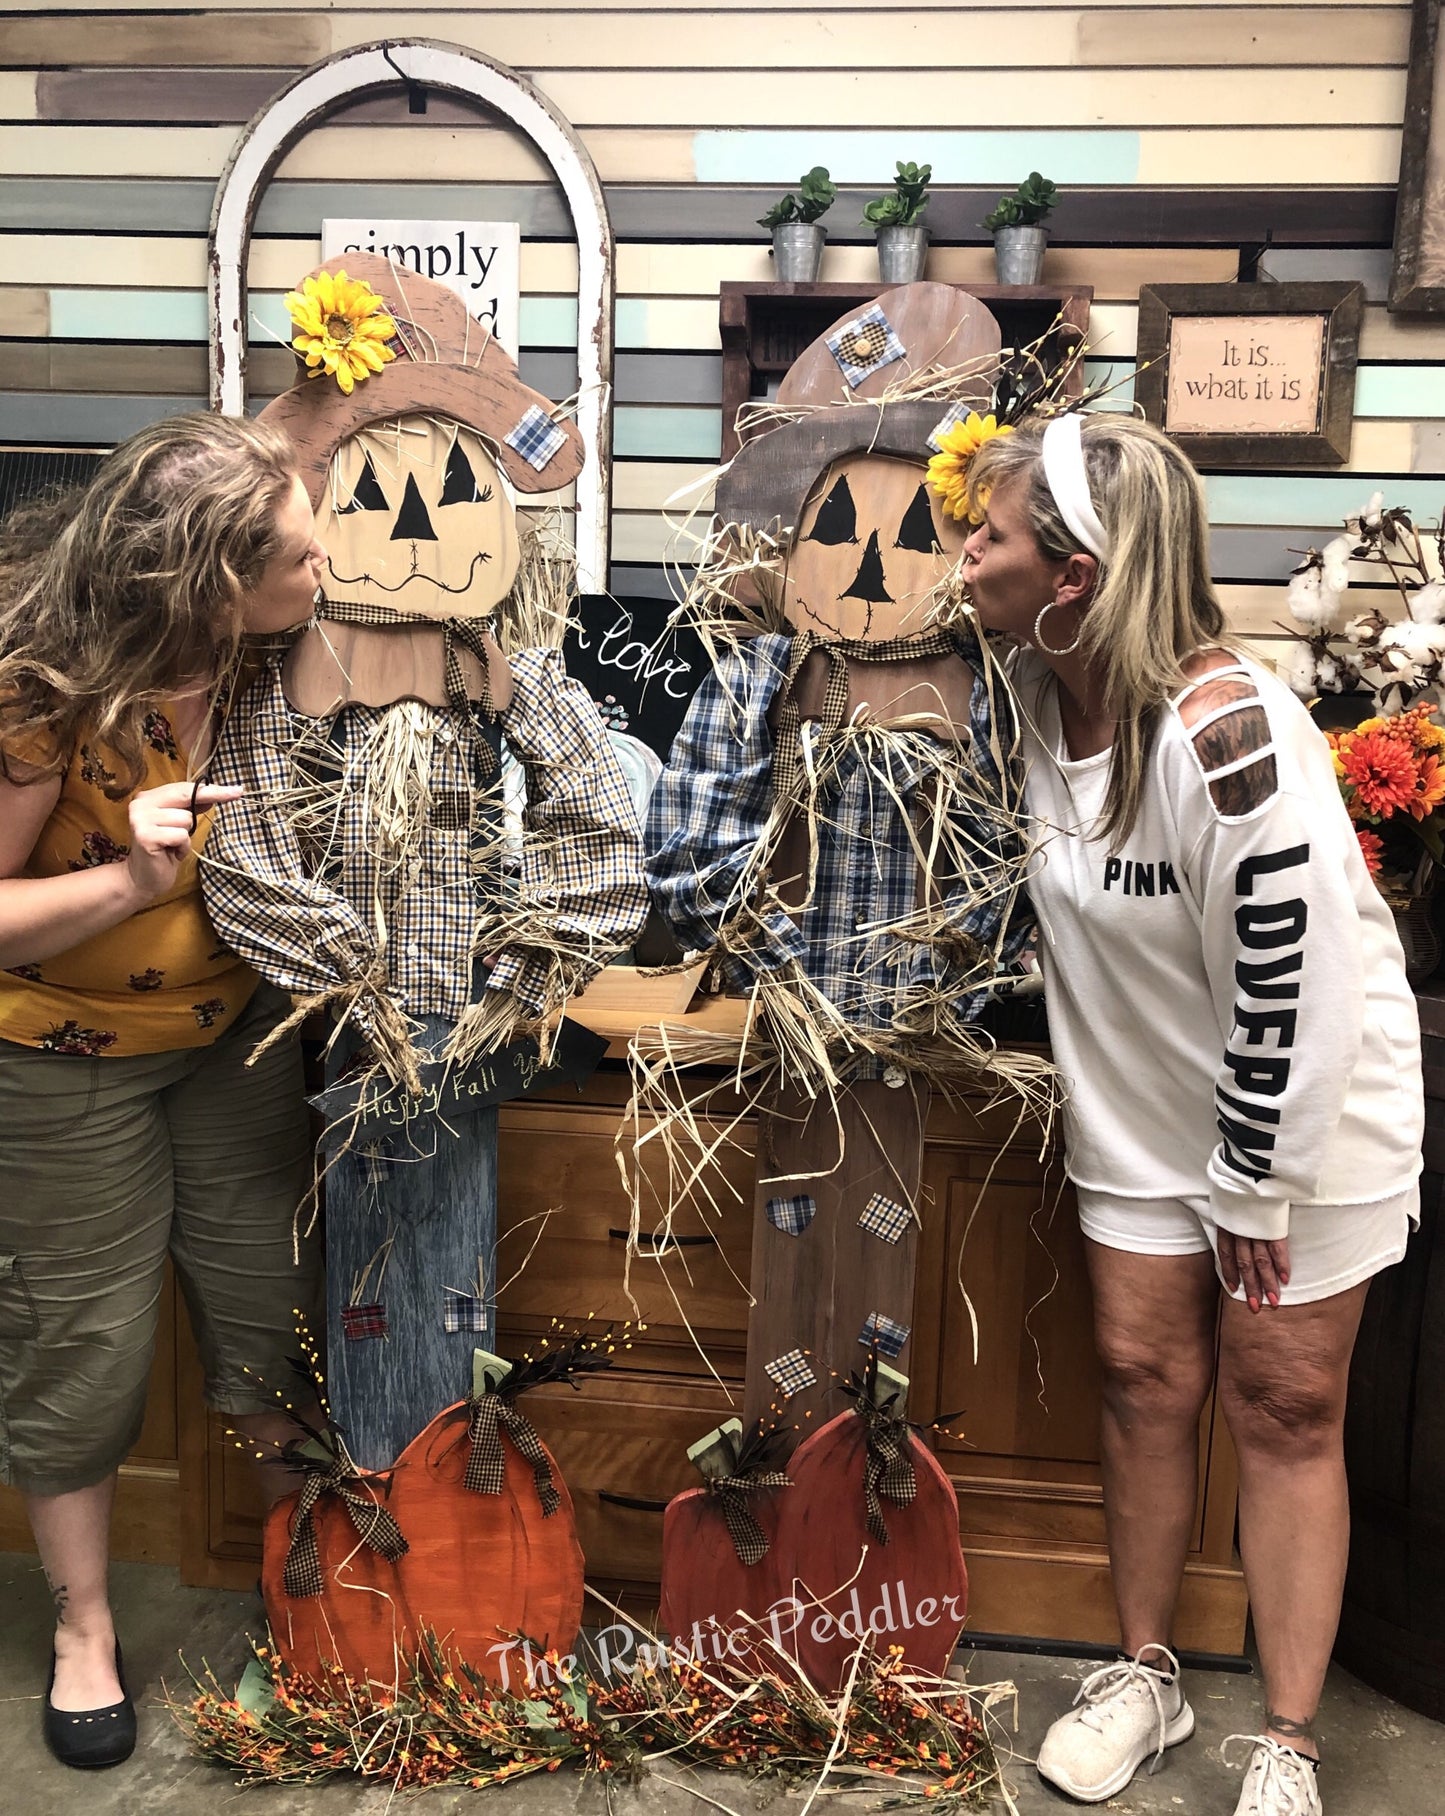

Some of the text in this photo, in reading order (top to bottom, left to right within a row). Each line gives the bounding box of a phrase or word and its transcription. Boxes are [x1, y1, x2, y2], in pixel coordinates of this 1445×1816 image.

[344, 230, 499, 289] mply
[1222, 338, 1286, 366] It is...
[1186, 373, 1301, 400] what it is
[1104, 856, 1181, 896] PINK
[453, 1067, 497, 1100] Fall
